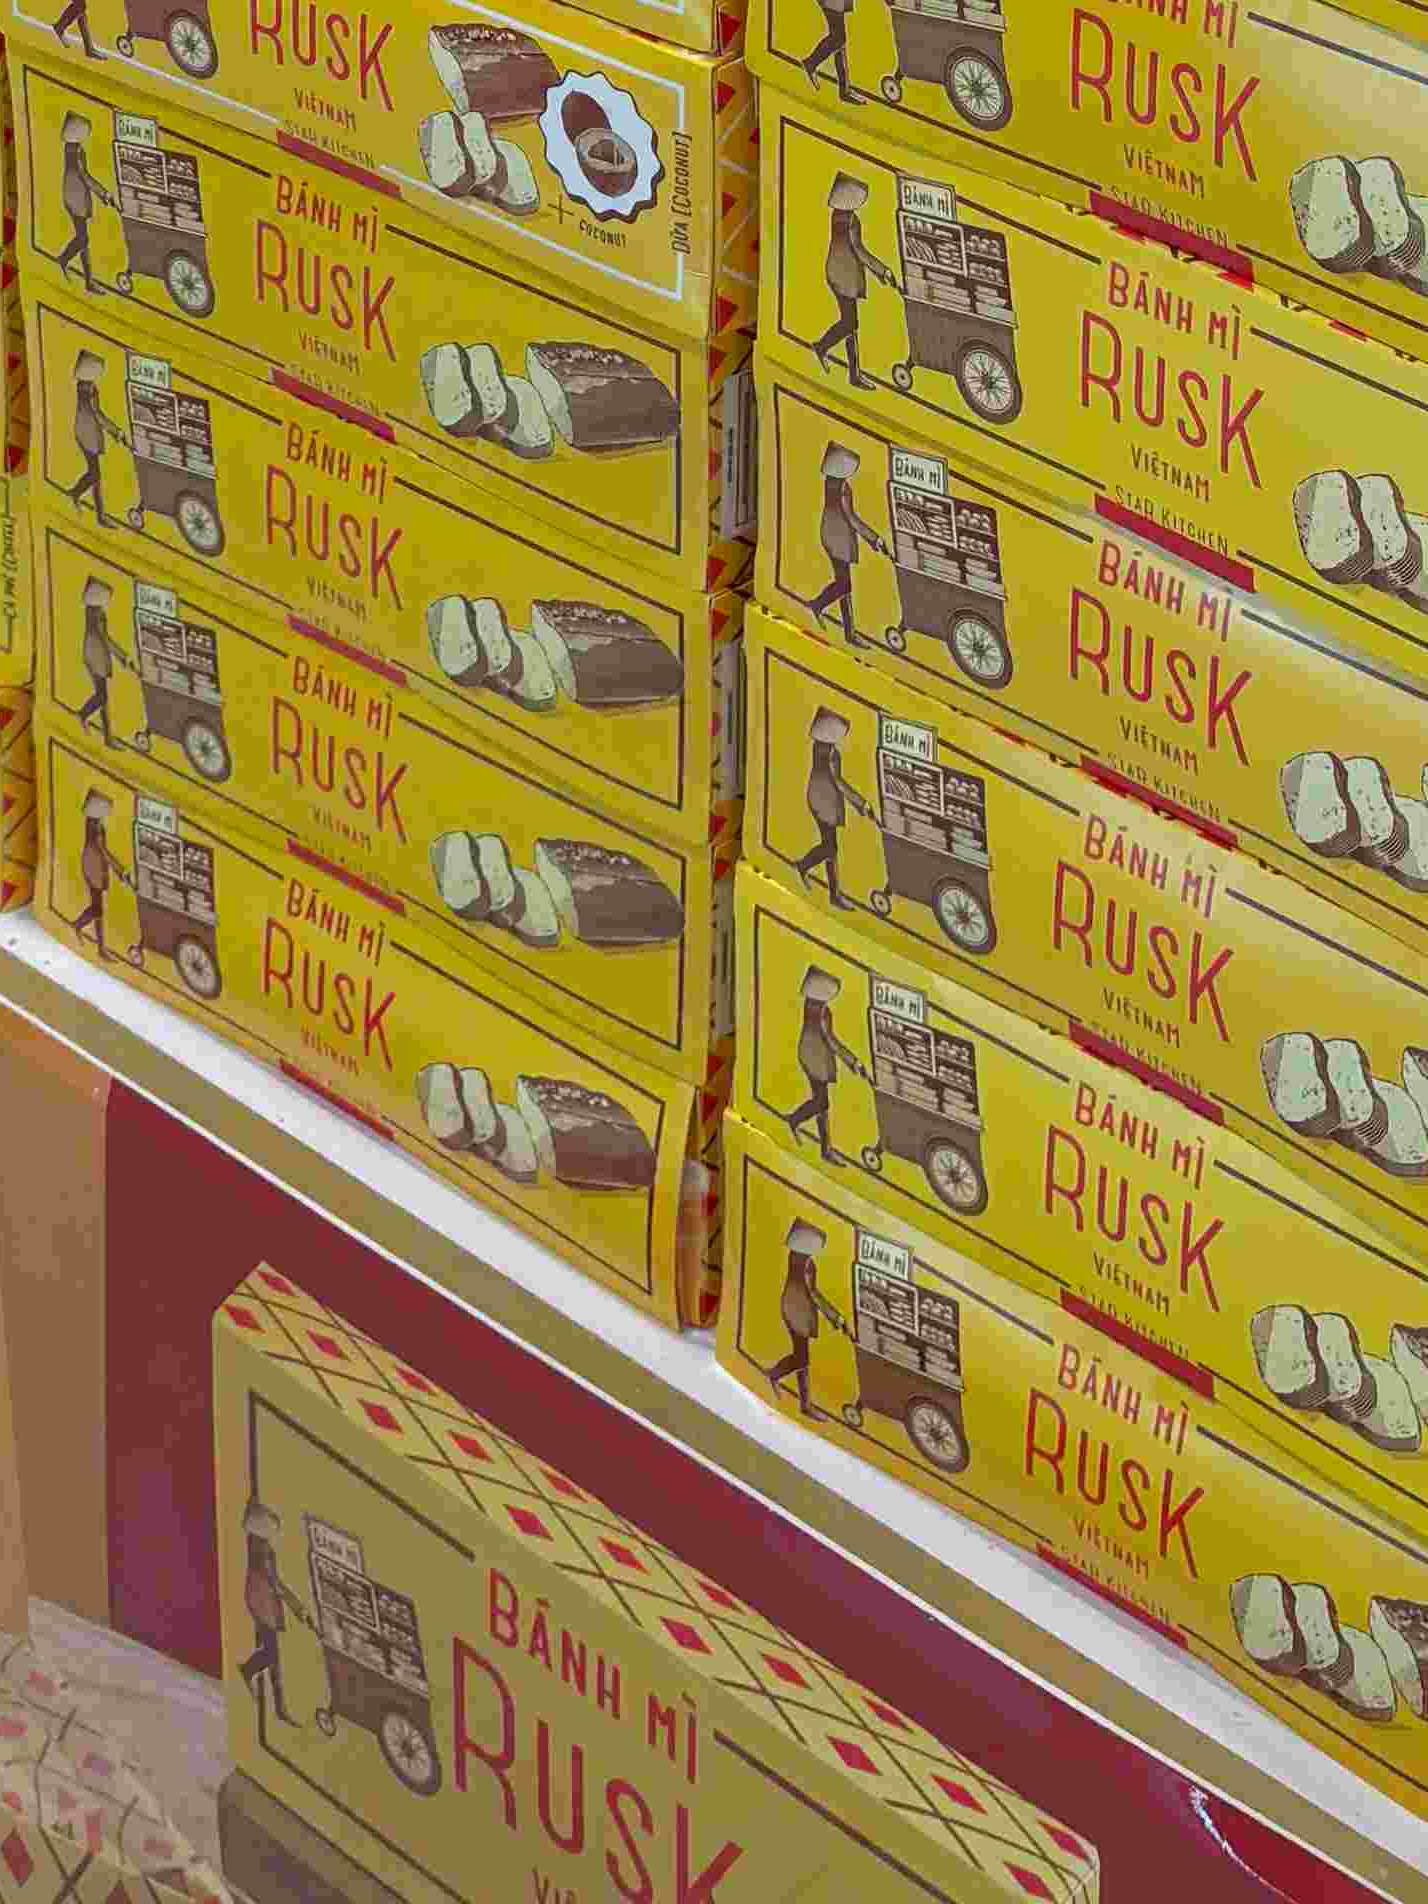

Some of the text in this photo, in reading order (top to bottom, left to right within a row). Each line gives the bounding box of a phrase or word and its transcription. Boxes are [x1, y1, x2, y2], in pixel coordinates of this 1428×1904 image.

[1024, 1389, 1205, 1578] RUSK
[1056, 1339, 1192, 1459] BÁNH MÌ
[488, 1567, 698, 1785] BÁNH MÌ
